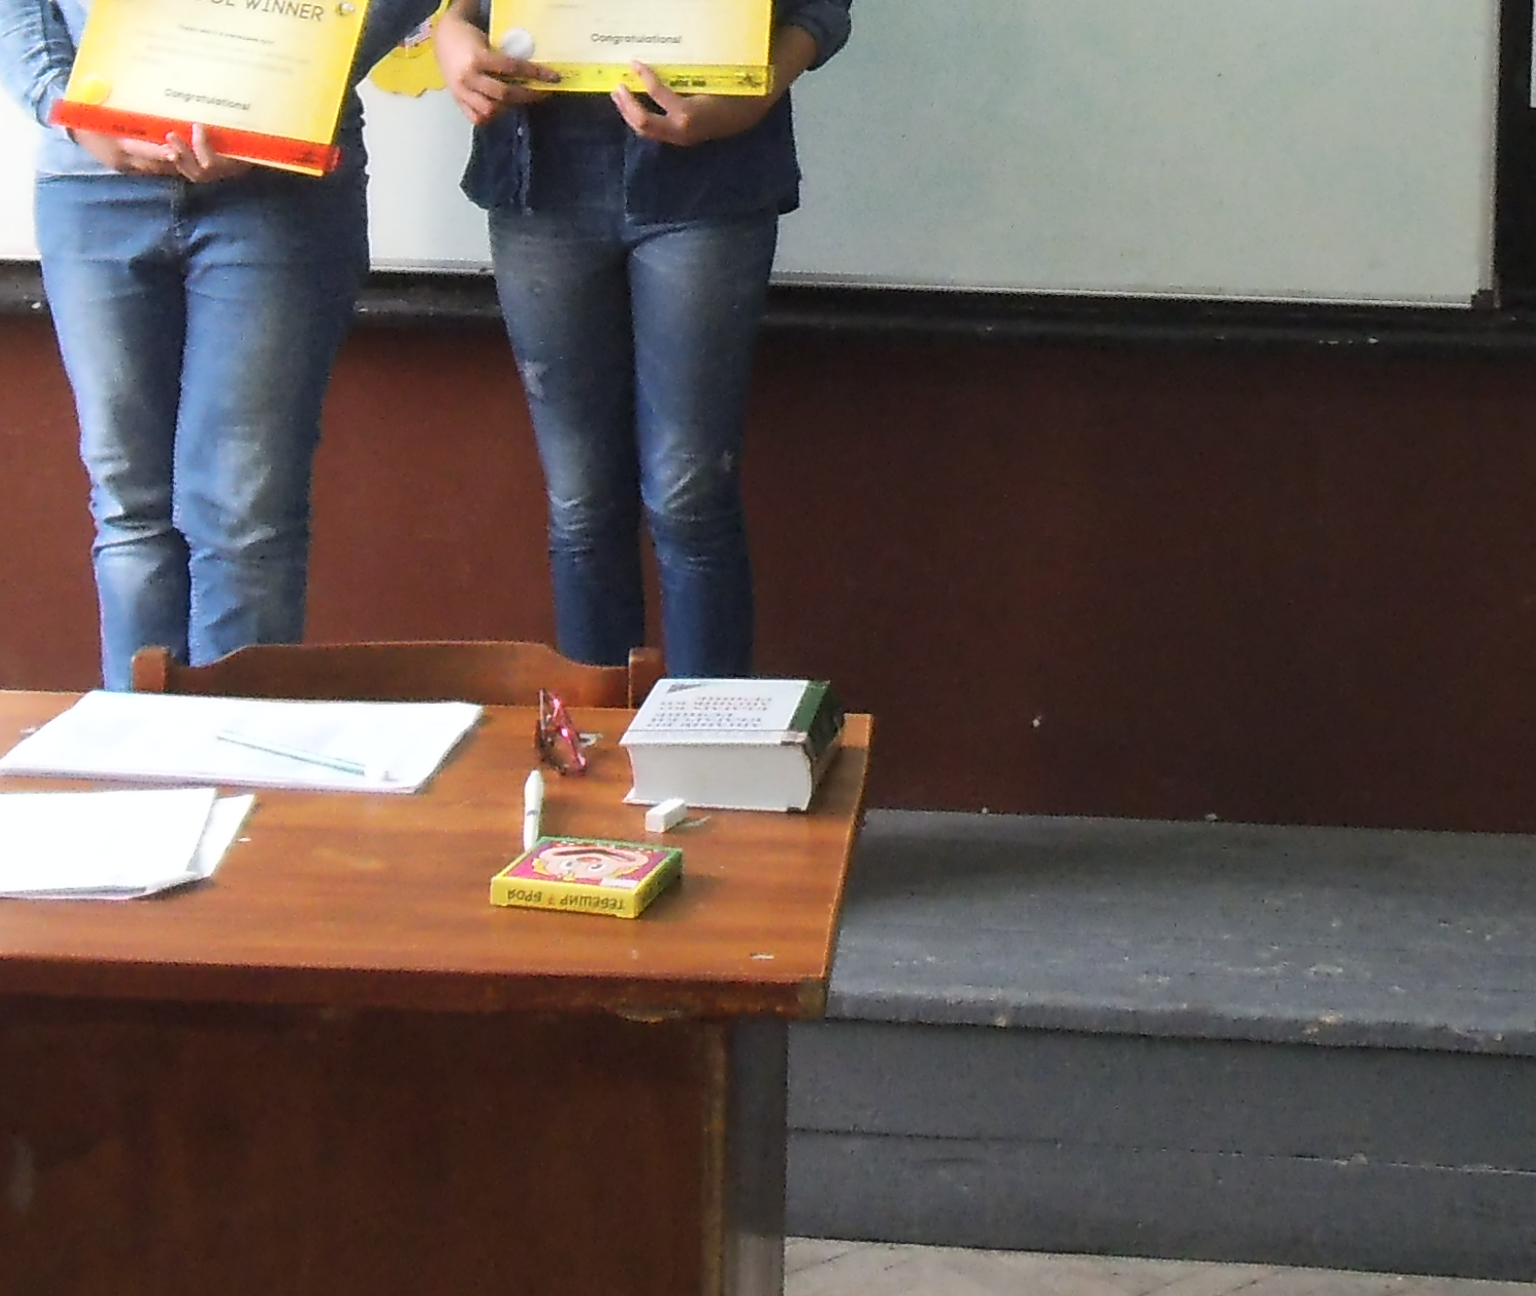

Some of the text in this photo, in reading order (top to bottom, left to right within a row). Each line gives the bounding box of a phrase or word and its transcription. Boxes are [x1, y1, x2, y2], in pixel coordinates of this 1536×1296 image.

[590, 32, 683, 46] Congratulations!
[164, 87, 252, 112] Congratulations!
[507, 888, 543, 903] БРОЯ
[560, 893, 625, 910] ТЕБЕШИР
